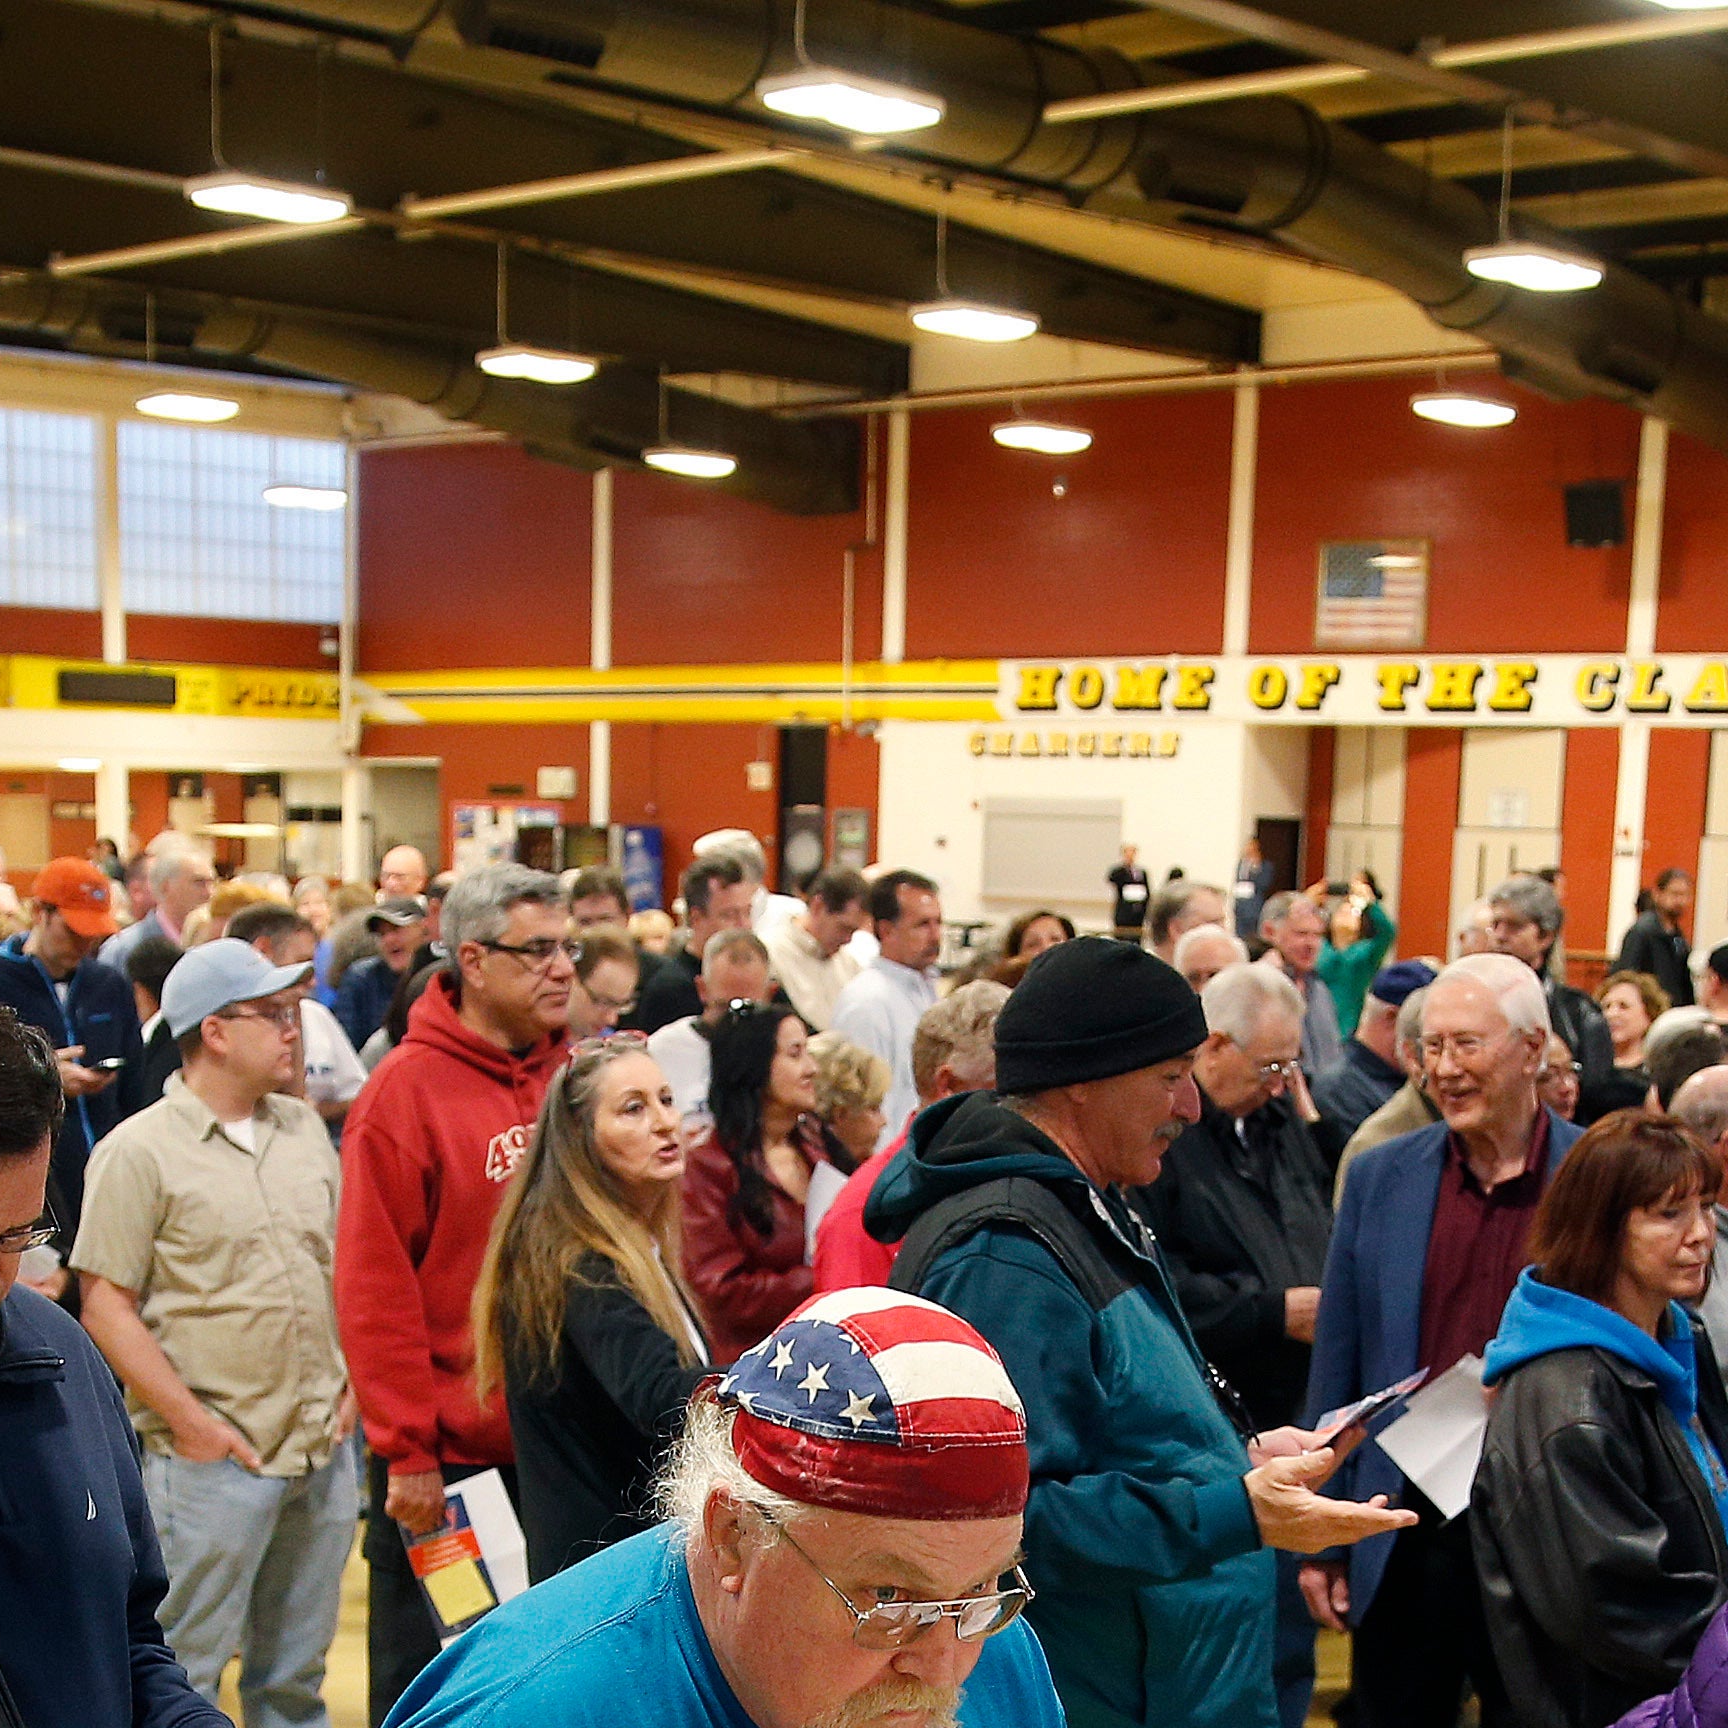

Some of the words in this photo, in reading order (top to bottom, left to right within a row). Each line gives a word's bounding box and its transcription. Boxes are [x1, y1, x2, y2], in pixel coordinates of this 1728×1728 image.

[1015, 662, 1215, 712] HOME
[1247, 662, 1341, 711] OF
[1375, 661, 1538, 714] THE
